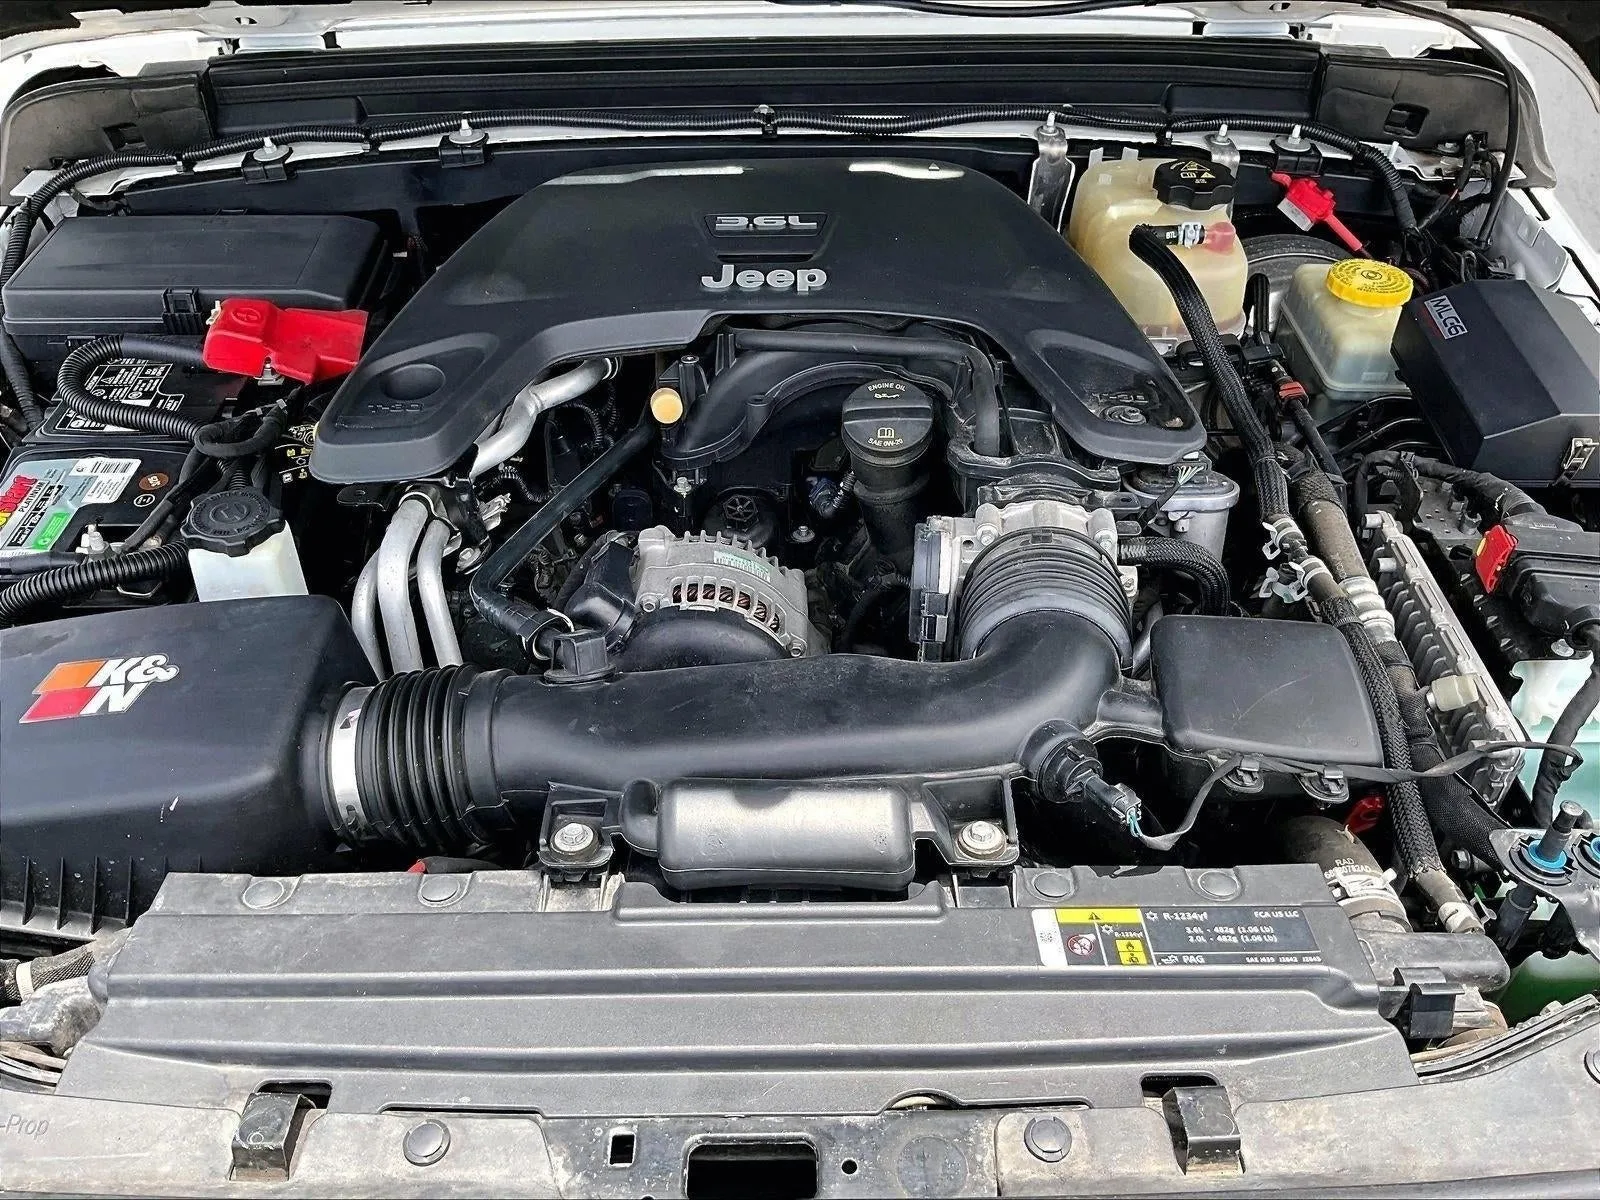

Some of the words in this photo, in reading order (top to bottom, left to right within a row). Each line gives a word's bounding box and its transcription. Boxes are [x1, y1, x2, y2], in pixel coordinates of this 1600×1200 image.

[715, 215, 818, 231] 3.6L
[701, 264, 828, 295] Jeep
[868, 382, 895, 392] ENGINE
[895, 384, 907, 392] OIL
[867, 437, 882, 447] SAE
[18, 481, 45, 513] PLATINUM
[1335, 857, 1355, 867] RAD
[1162, 911, 1208, 921] R-1234yf
[1254, 910, 1271, 918] FCA
[1271, 910, 1284, 918] US
[1284, 910, 1299, 918] LLC
[1182, 955, 1205, 964] PAG
